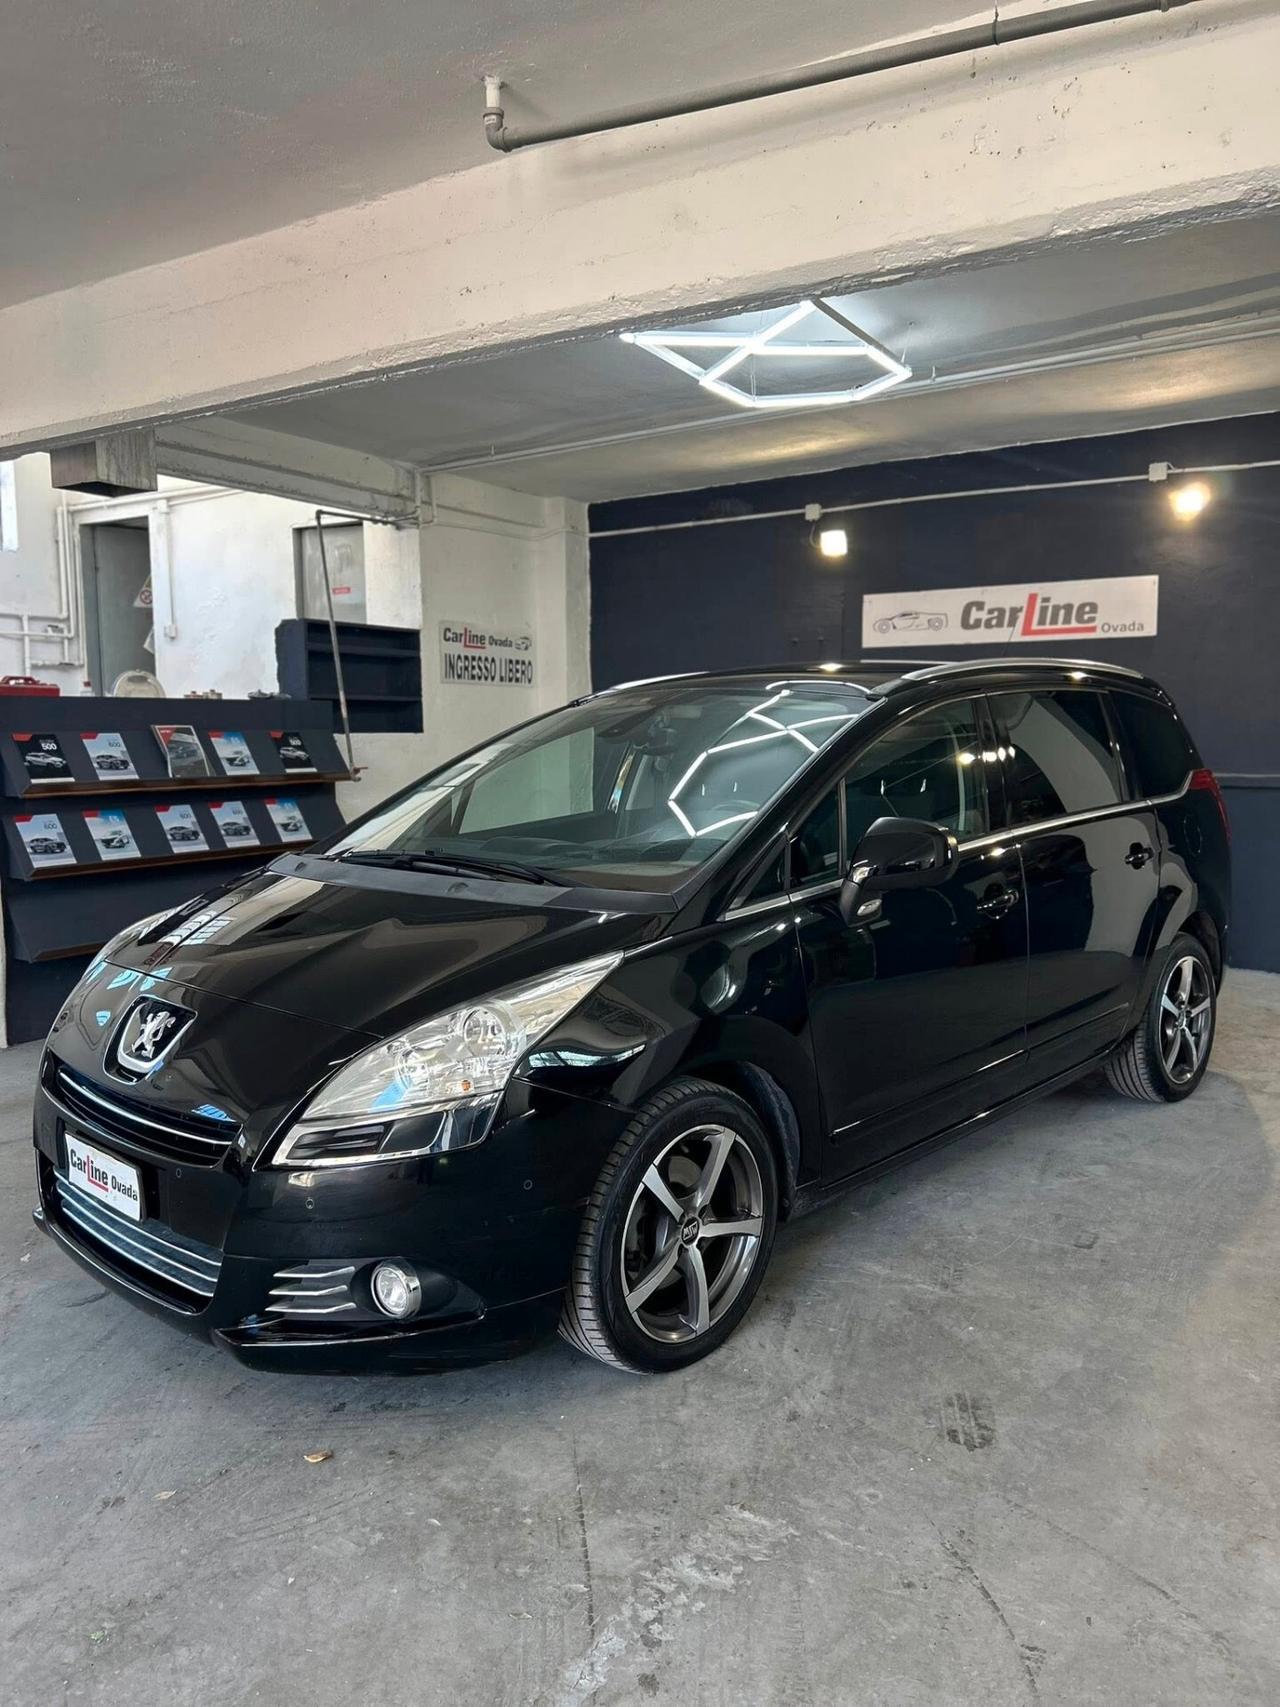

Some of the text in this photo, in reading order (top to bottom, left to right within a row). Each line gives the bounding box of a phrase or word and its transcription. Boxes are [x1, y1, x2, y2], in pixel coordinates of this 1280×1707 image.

[960, 593, 1145, 636] CarLine Ovada
[443, 626, 513, 650] CarLine Ovada
[444, 653, 533, 684] INGRESSO LIBERO
[69, 1148, 139, 1202] CarLine Ovada
